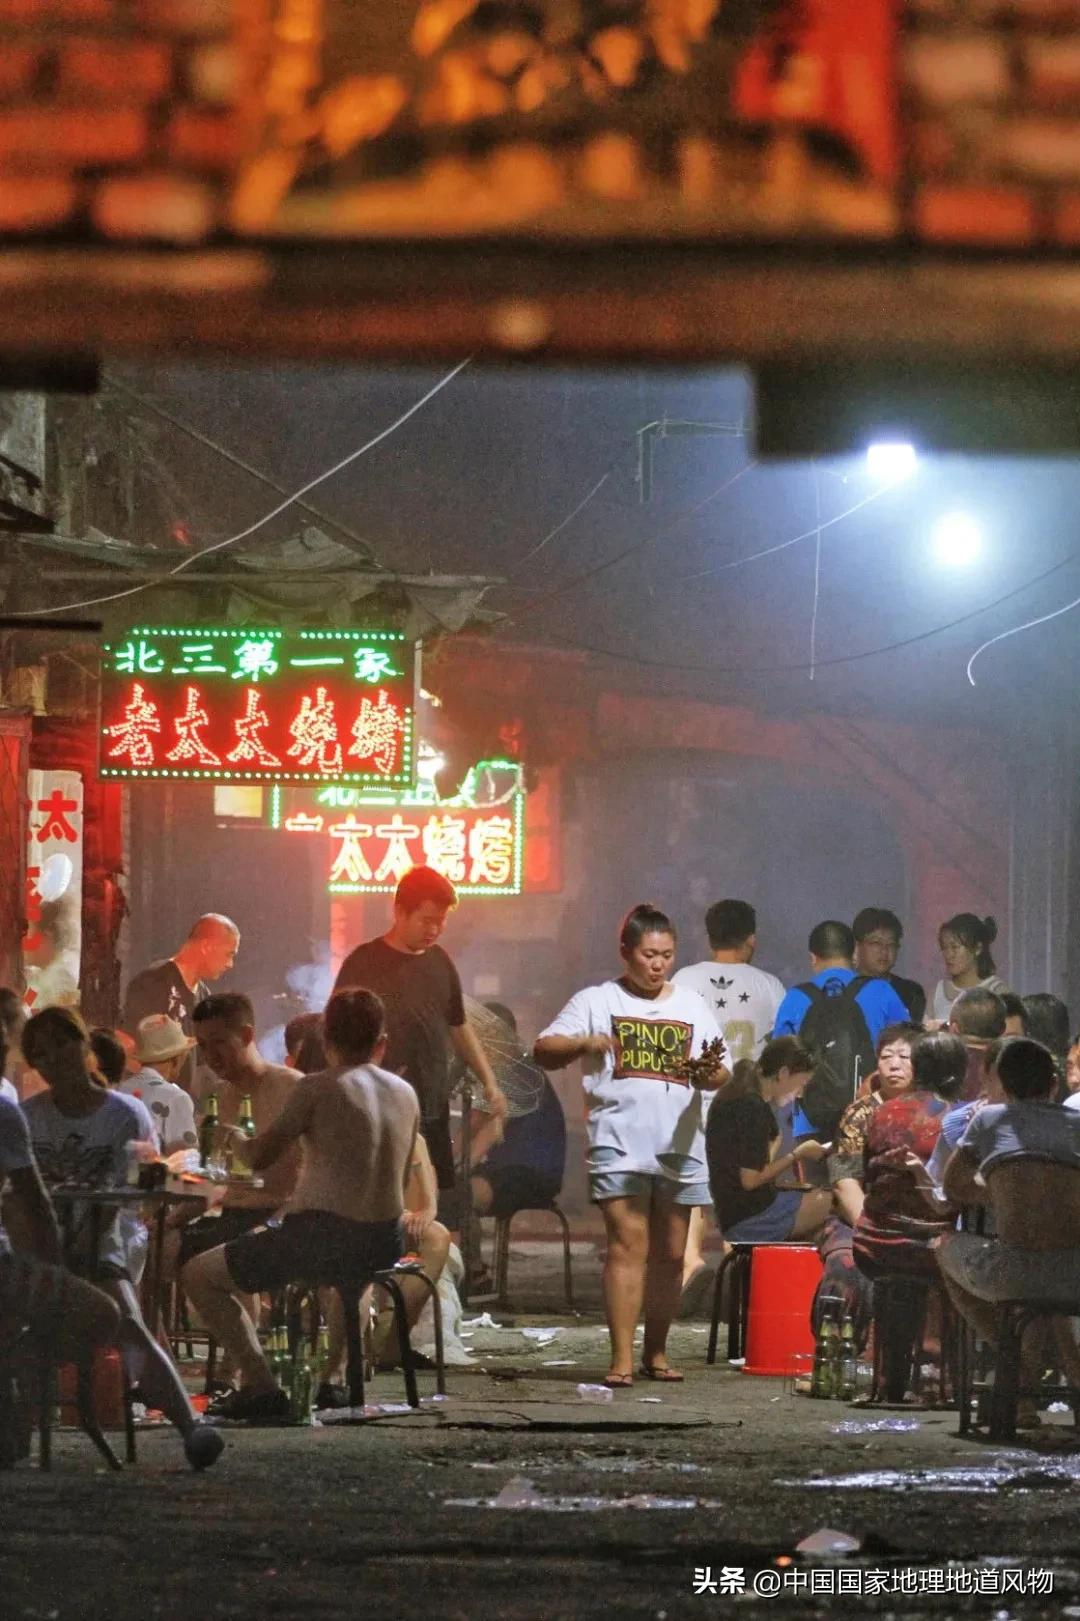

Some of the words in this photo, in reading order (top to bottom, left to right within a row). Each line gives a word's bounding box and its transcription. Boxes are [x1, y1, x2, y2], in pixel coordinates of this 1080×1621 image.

[115, 640, 404, 683] 北三第一家
[619, 1021, 688, 1053] PINOY
